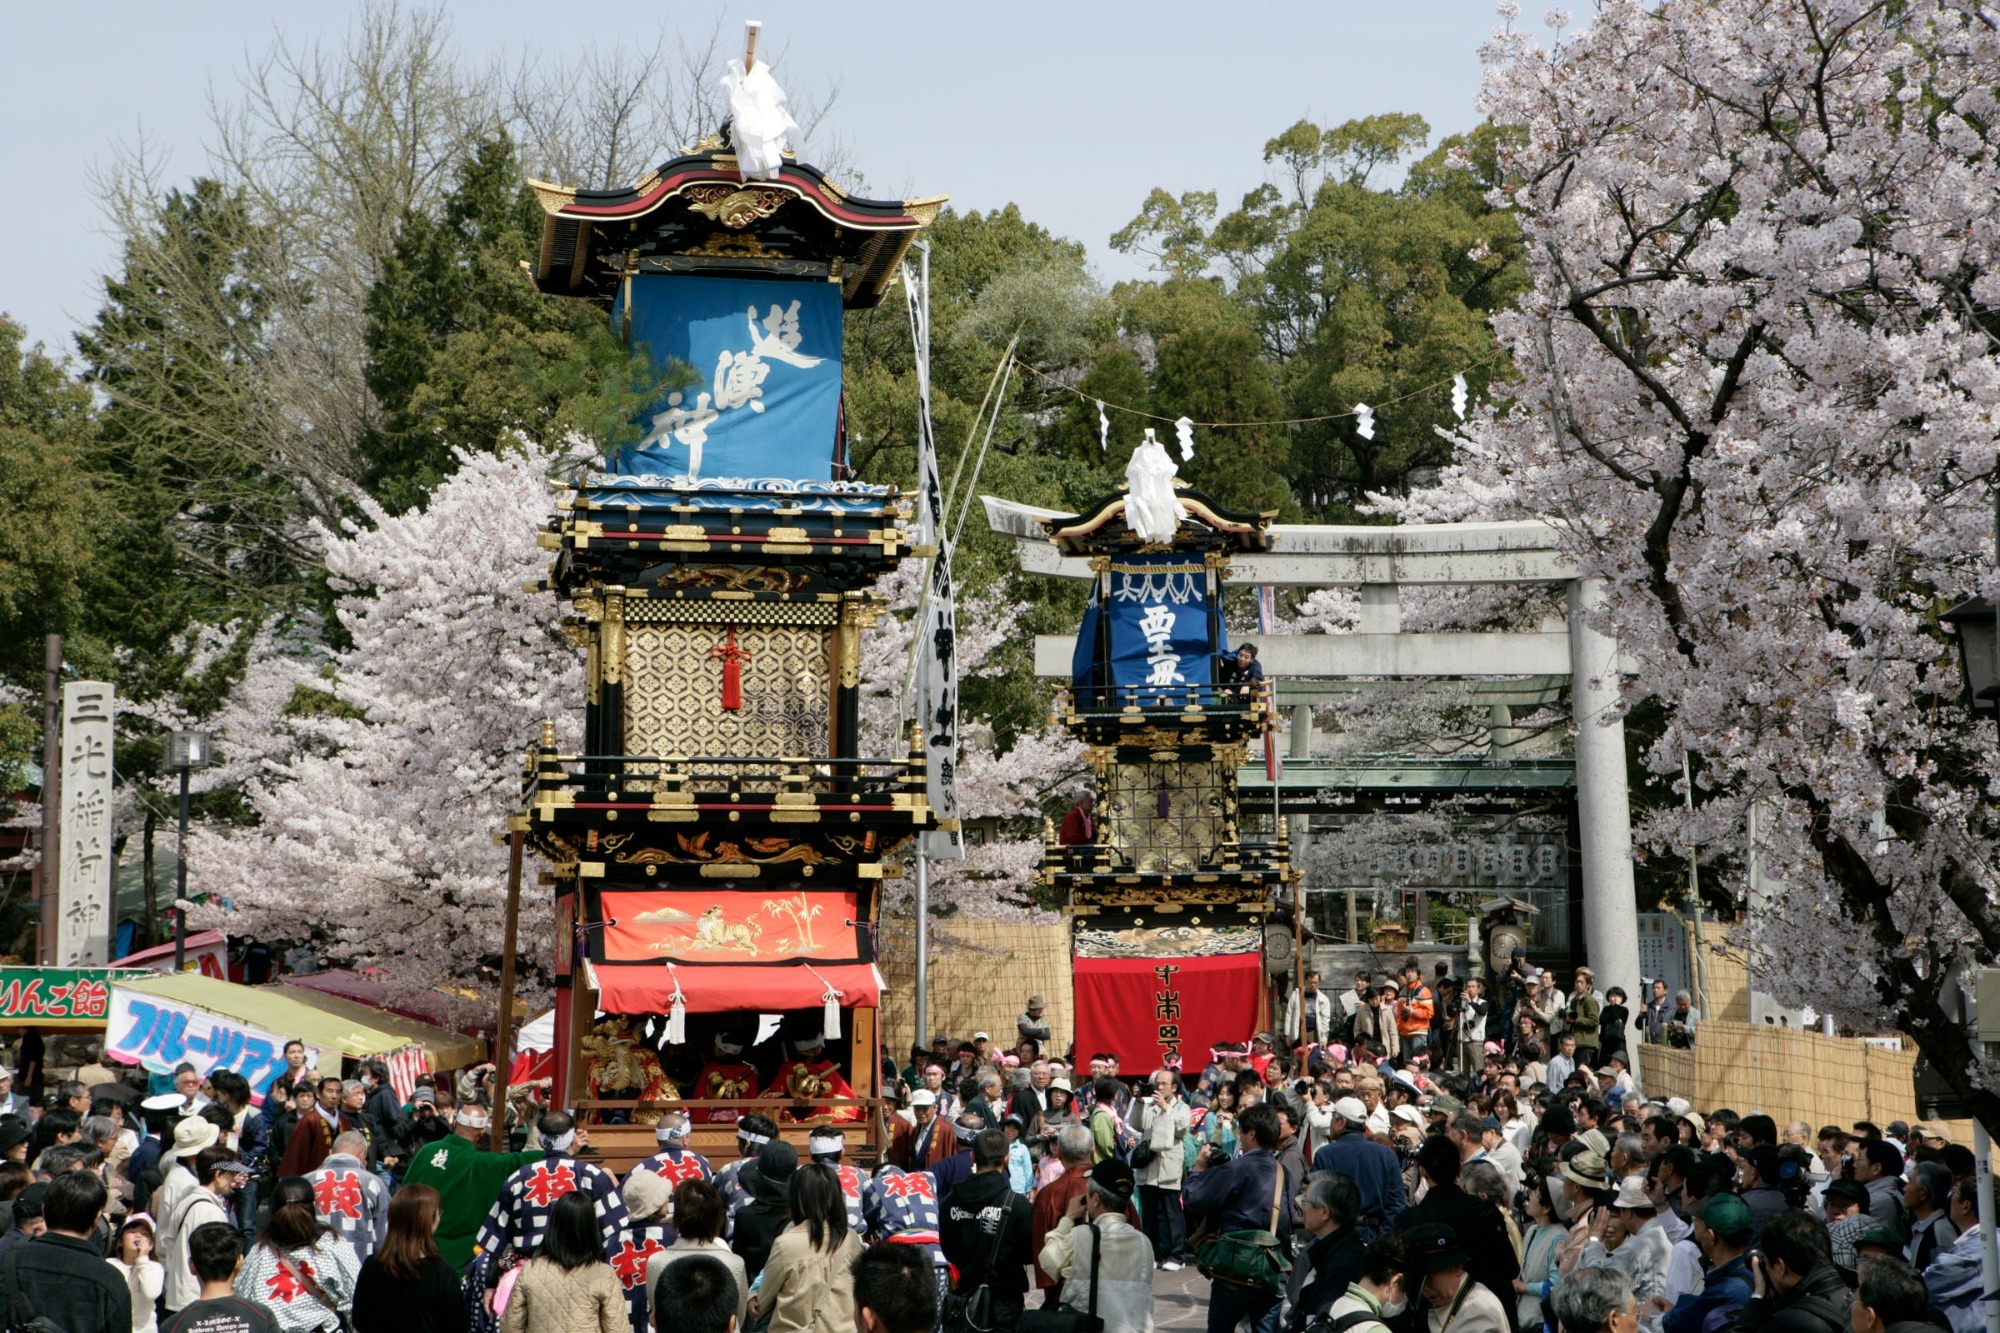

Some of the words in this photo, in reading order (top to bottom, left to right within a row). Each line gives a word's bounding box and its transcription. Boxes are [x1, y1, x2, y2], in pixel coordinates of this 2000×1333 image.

[0, 978, 109, 1017] りんご飴
[313, 1169, 363, 1220] 枝
